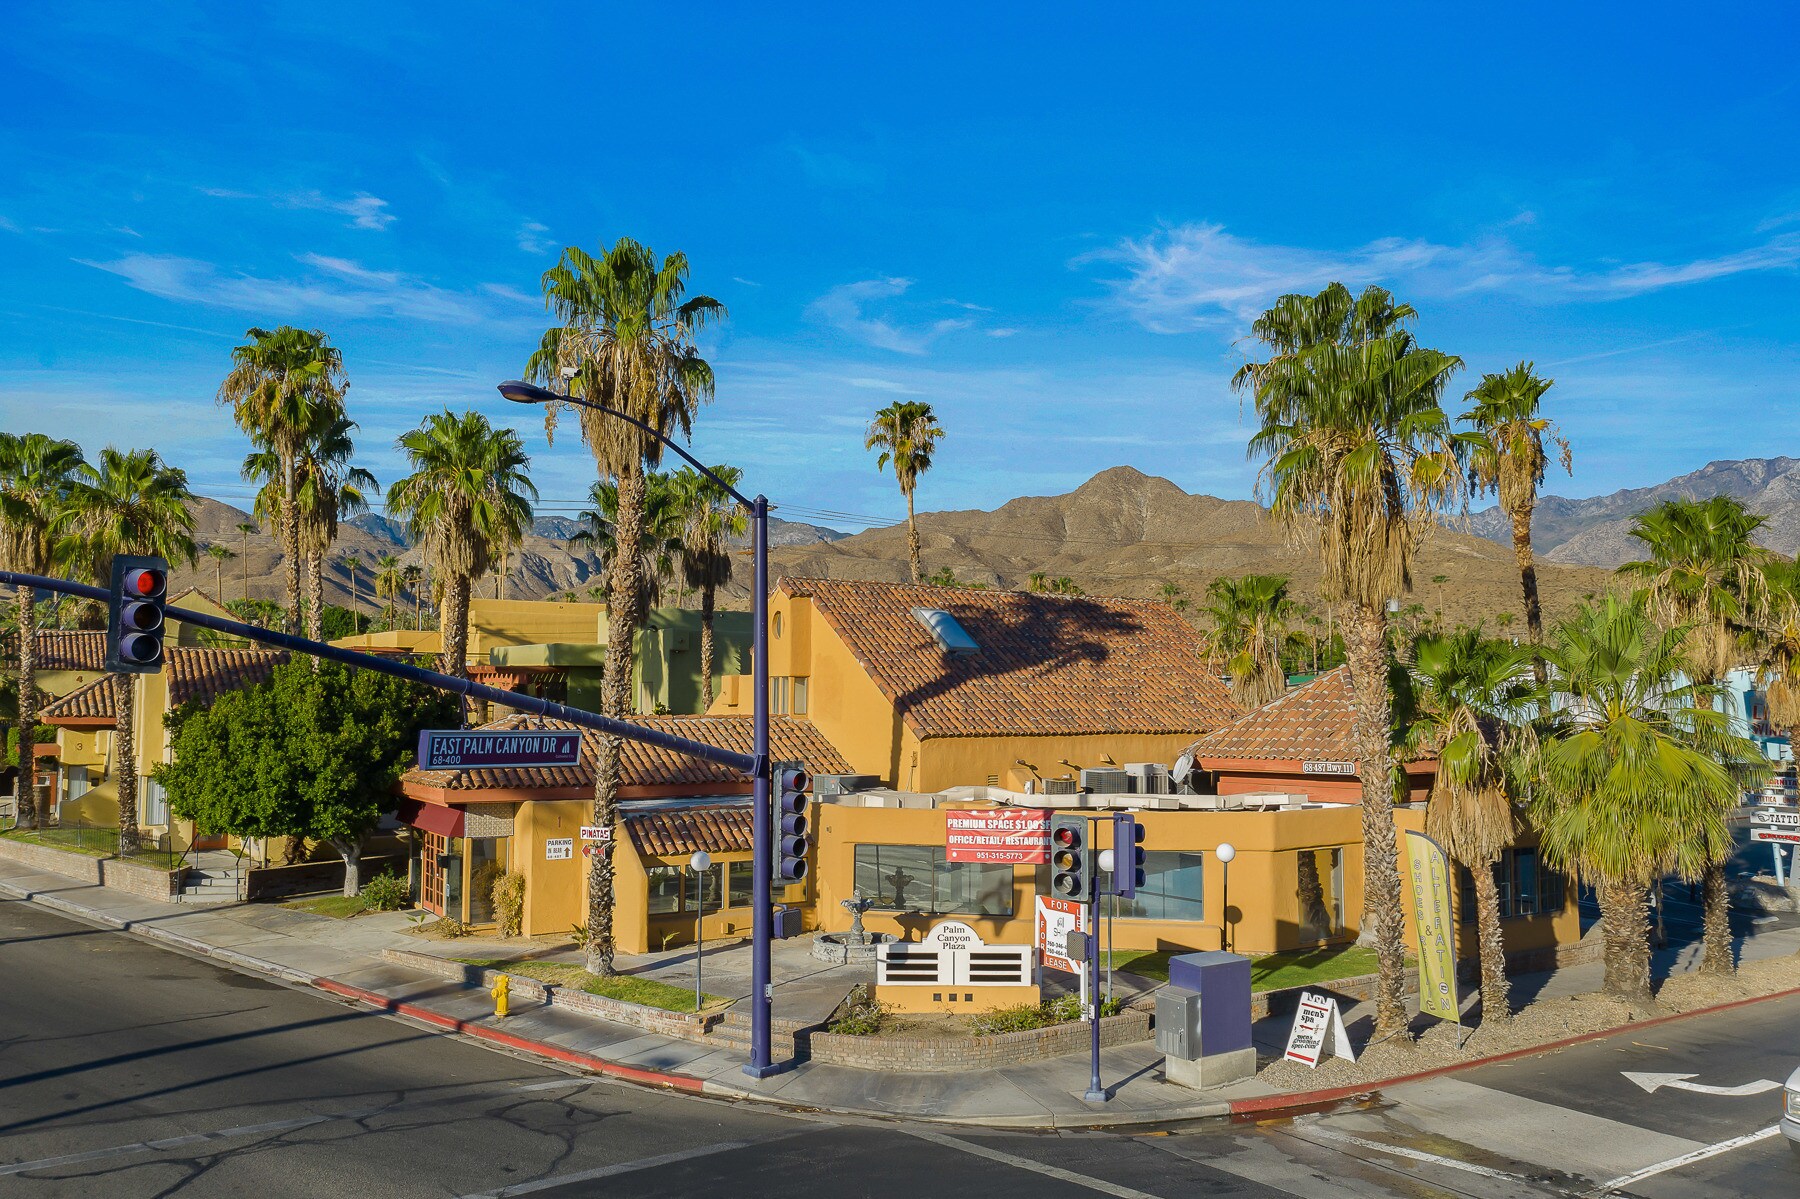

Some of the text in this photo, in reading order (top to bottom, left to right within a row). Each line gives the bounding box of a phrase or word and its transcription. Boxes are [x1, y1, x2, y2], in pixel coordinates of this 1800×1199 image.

[76, 742, 83, 751] 3
[433, 738, 556, 754] EAST PALM CANYON DR
[432, 756, 461, 764] 68-400
[1304, 764, 1325, 772] 68-487
[948, 818, 986, 828] PREMIUM
[988, 820, 1014, 829] SPACE
[1016, 820, 1038, 830] $1.00
[582, 830, 609, 838] PINATAS
[1414, 859, 1424, 920] SHOES
[1052, 900, 1068, 911] FOR
[1426, 925, 1433, 936] &
[938, 934, 970, 943] Canyon
[1046, 957, 1067, 969] LEASE
[1303, 1009, 1324, 1018] men's
[1301, 1015, 1315, 1023] spa
